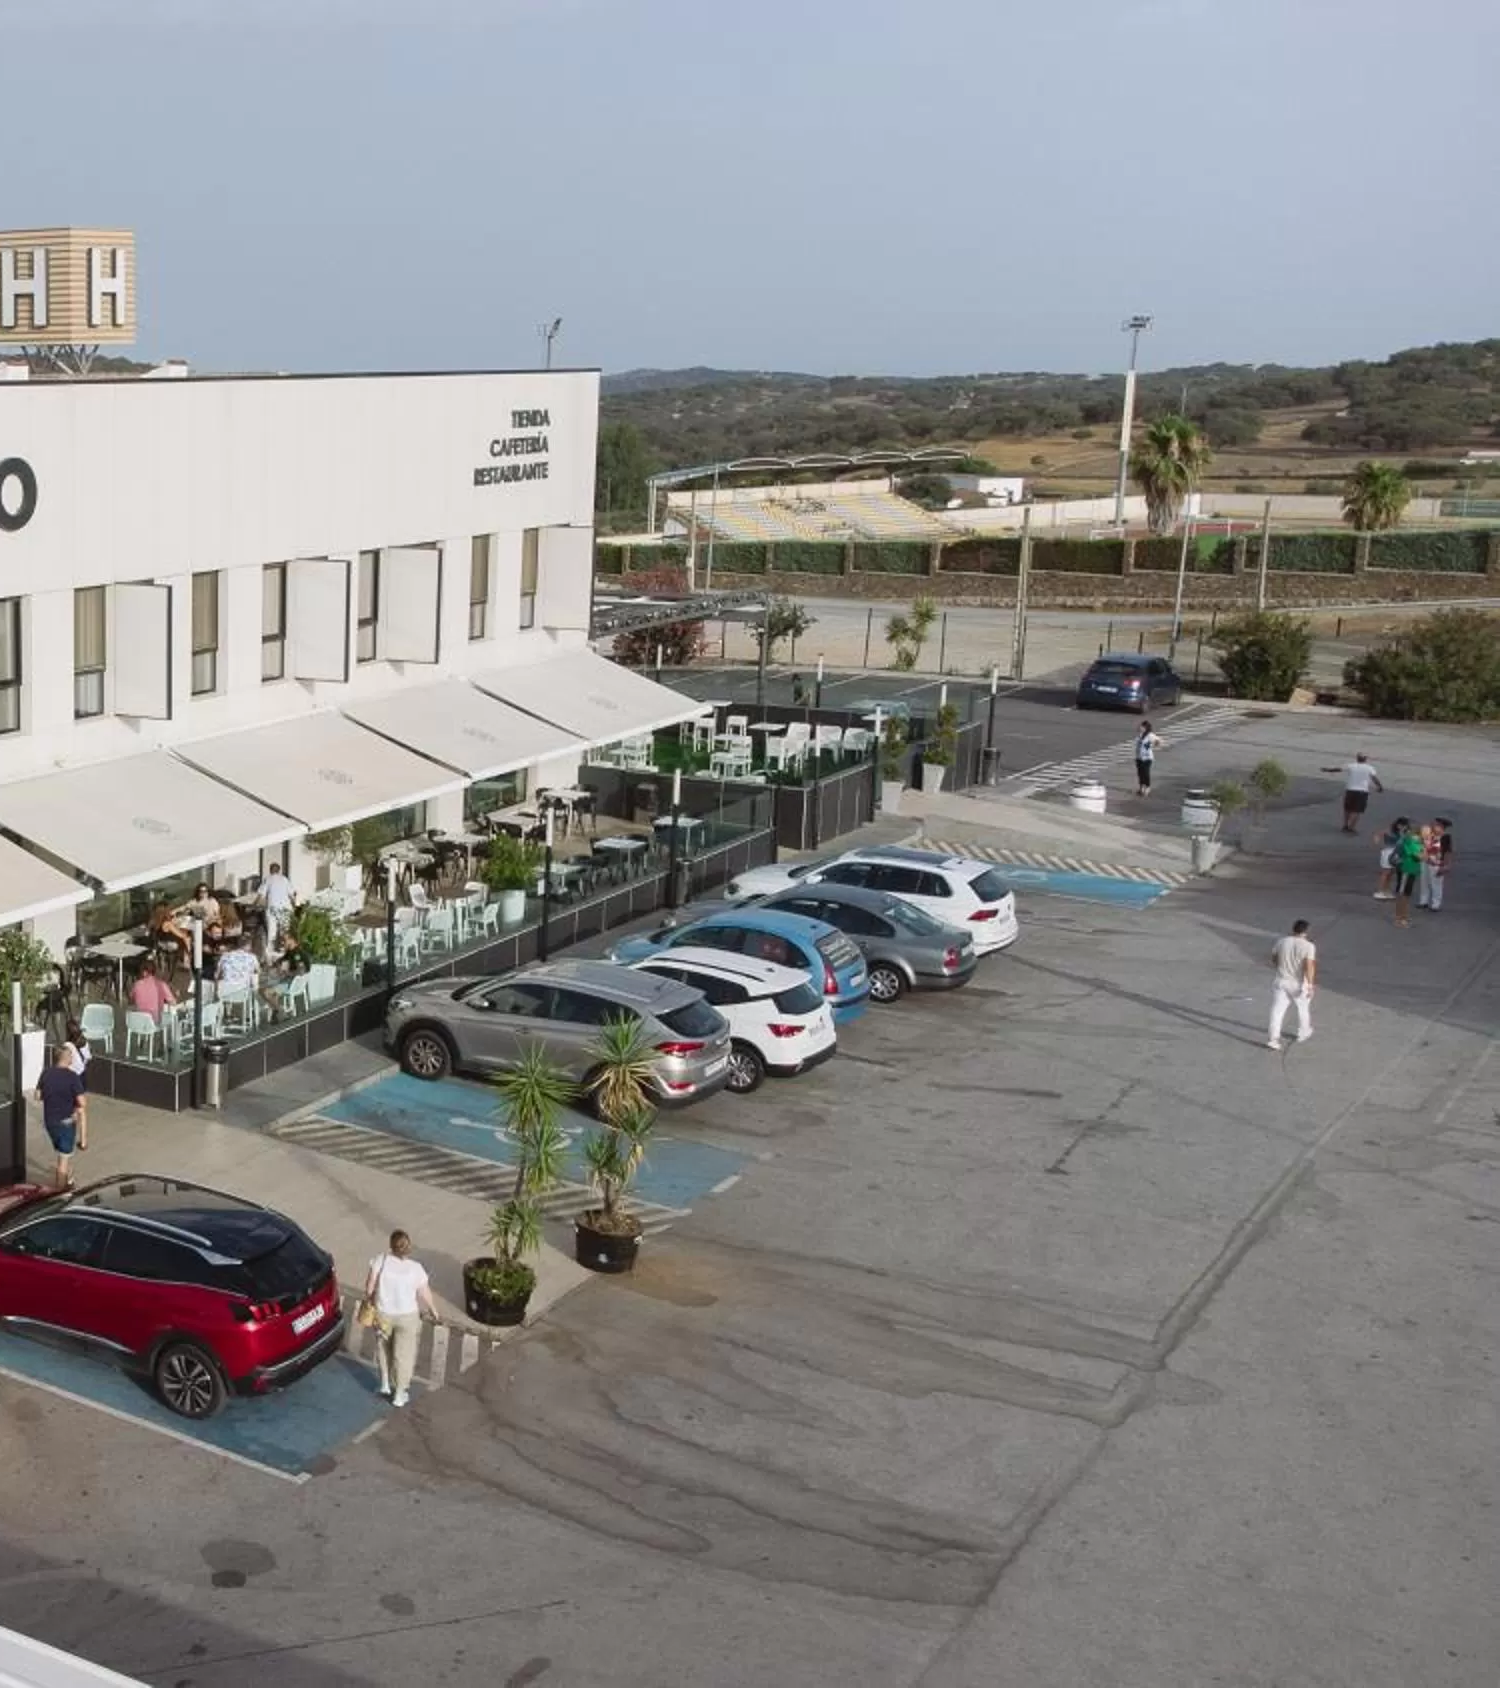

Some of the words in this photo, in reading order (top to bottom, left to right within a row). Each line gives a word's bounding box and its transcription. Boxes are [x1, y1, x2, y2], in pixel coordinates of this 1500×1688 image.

[0, 247, 48, 328] H
[88, 247, 126, 327] H
[511, 408, 550, 428] TIENDA
[489, 431, 549, 457] CAFETERÍA
[473, 461, 549, 486] RESTAURANTE
